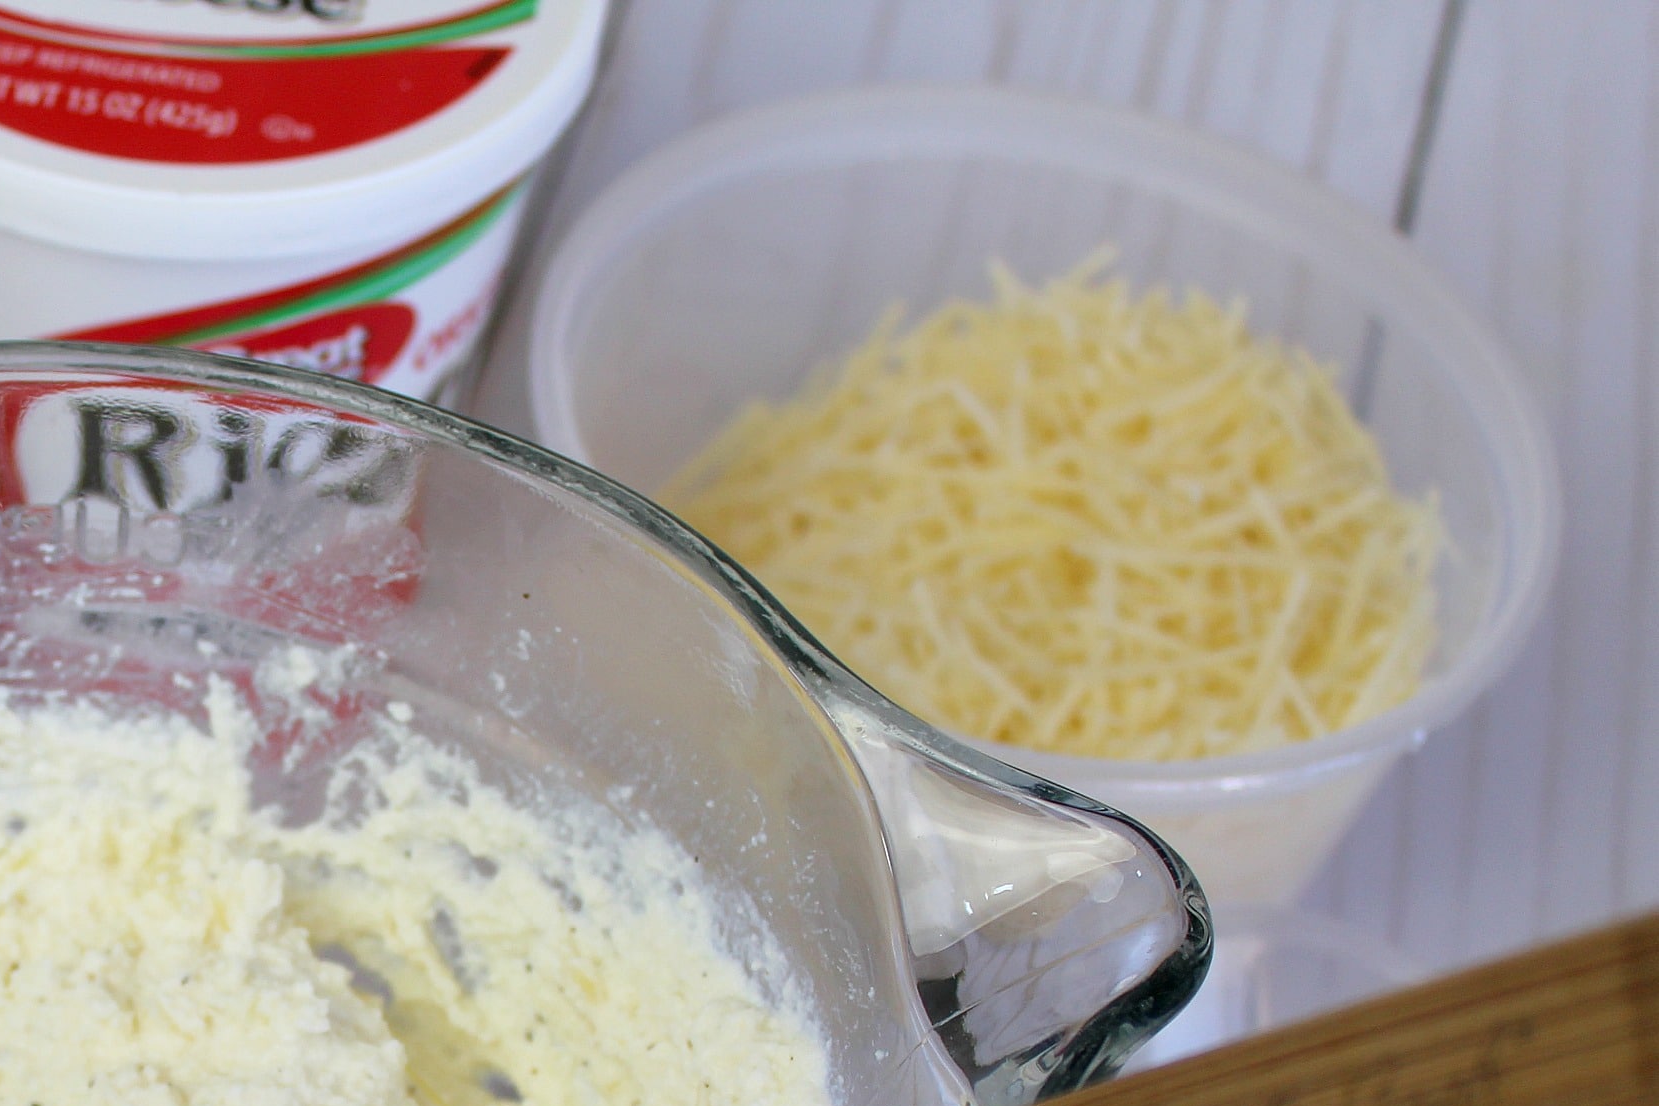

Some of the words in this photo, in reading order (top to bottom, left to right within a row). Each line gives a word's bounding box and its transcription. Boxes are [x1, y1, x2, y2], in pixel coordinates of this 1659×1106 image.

[12, 75, 64, 110] WT
[70, 83, 100, 118] 15
[101, 89, 144, 121] OZ
